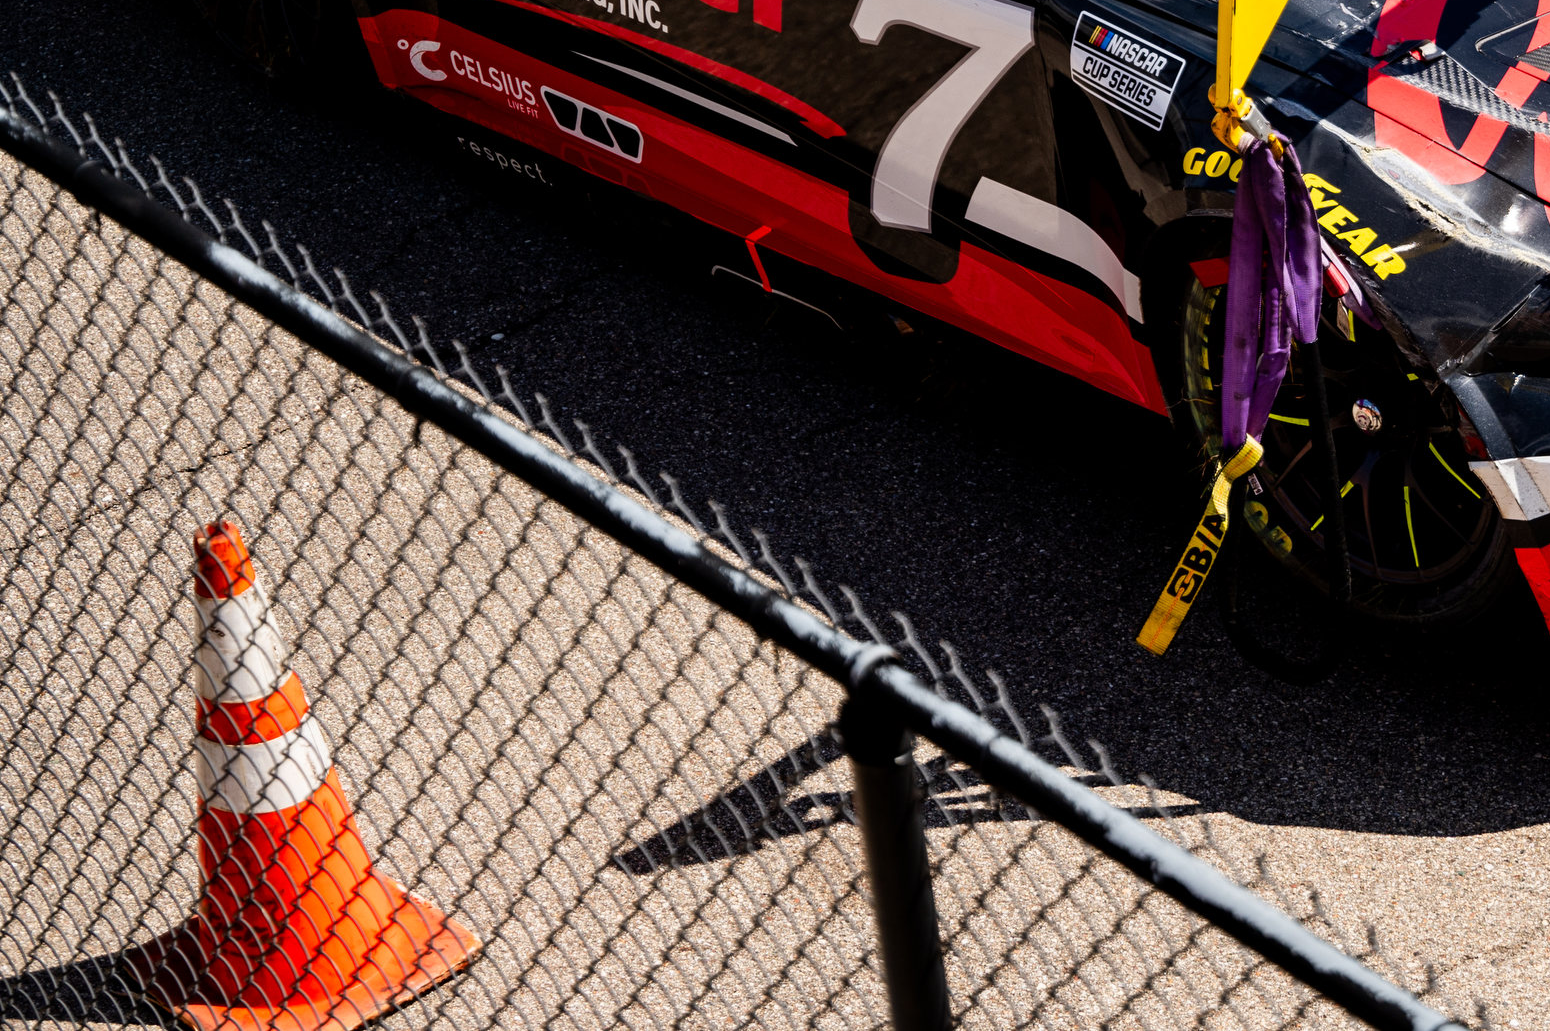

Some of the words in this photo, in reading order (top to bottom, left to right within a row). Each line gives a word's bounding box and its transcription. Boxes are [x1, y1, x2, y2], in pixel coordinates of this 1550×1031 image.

[1104, 31, 1168, 78] NASCAR
[1082, 55, 1108, 82] CUP
[1108, 63, 1157, 108] SERIES
[507, 98, 525, 113] LIVE
[527, 105, 539, 119] FIT
